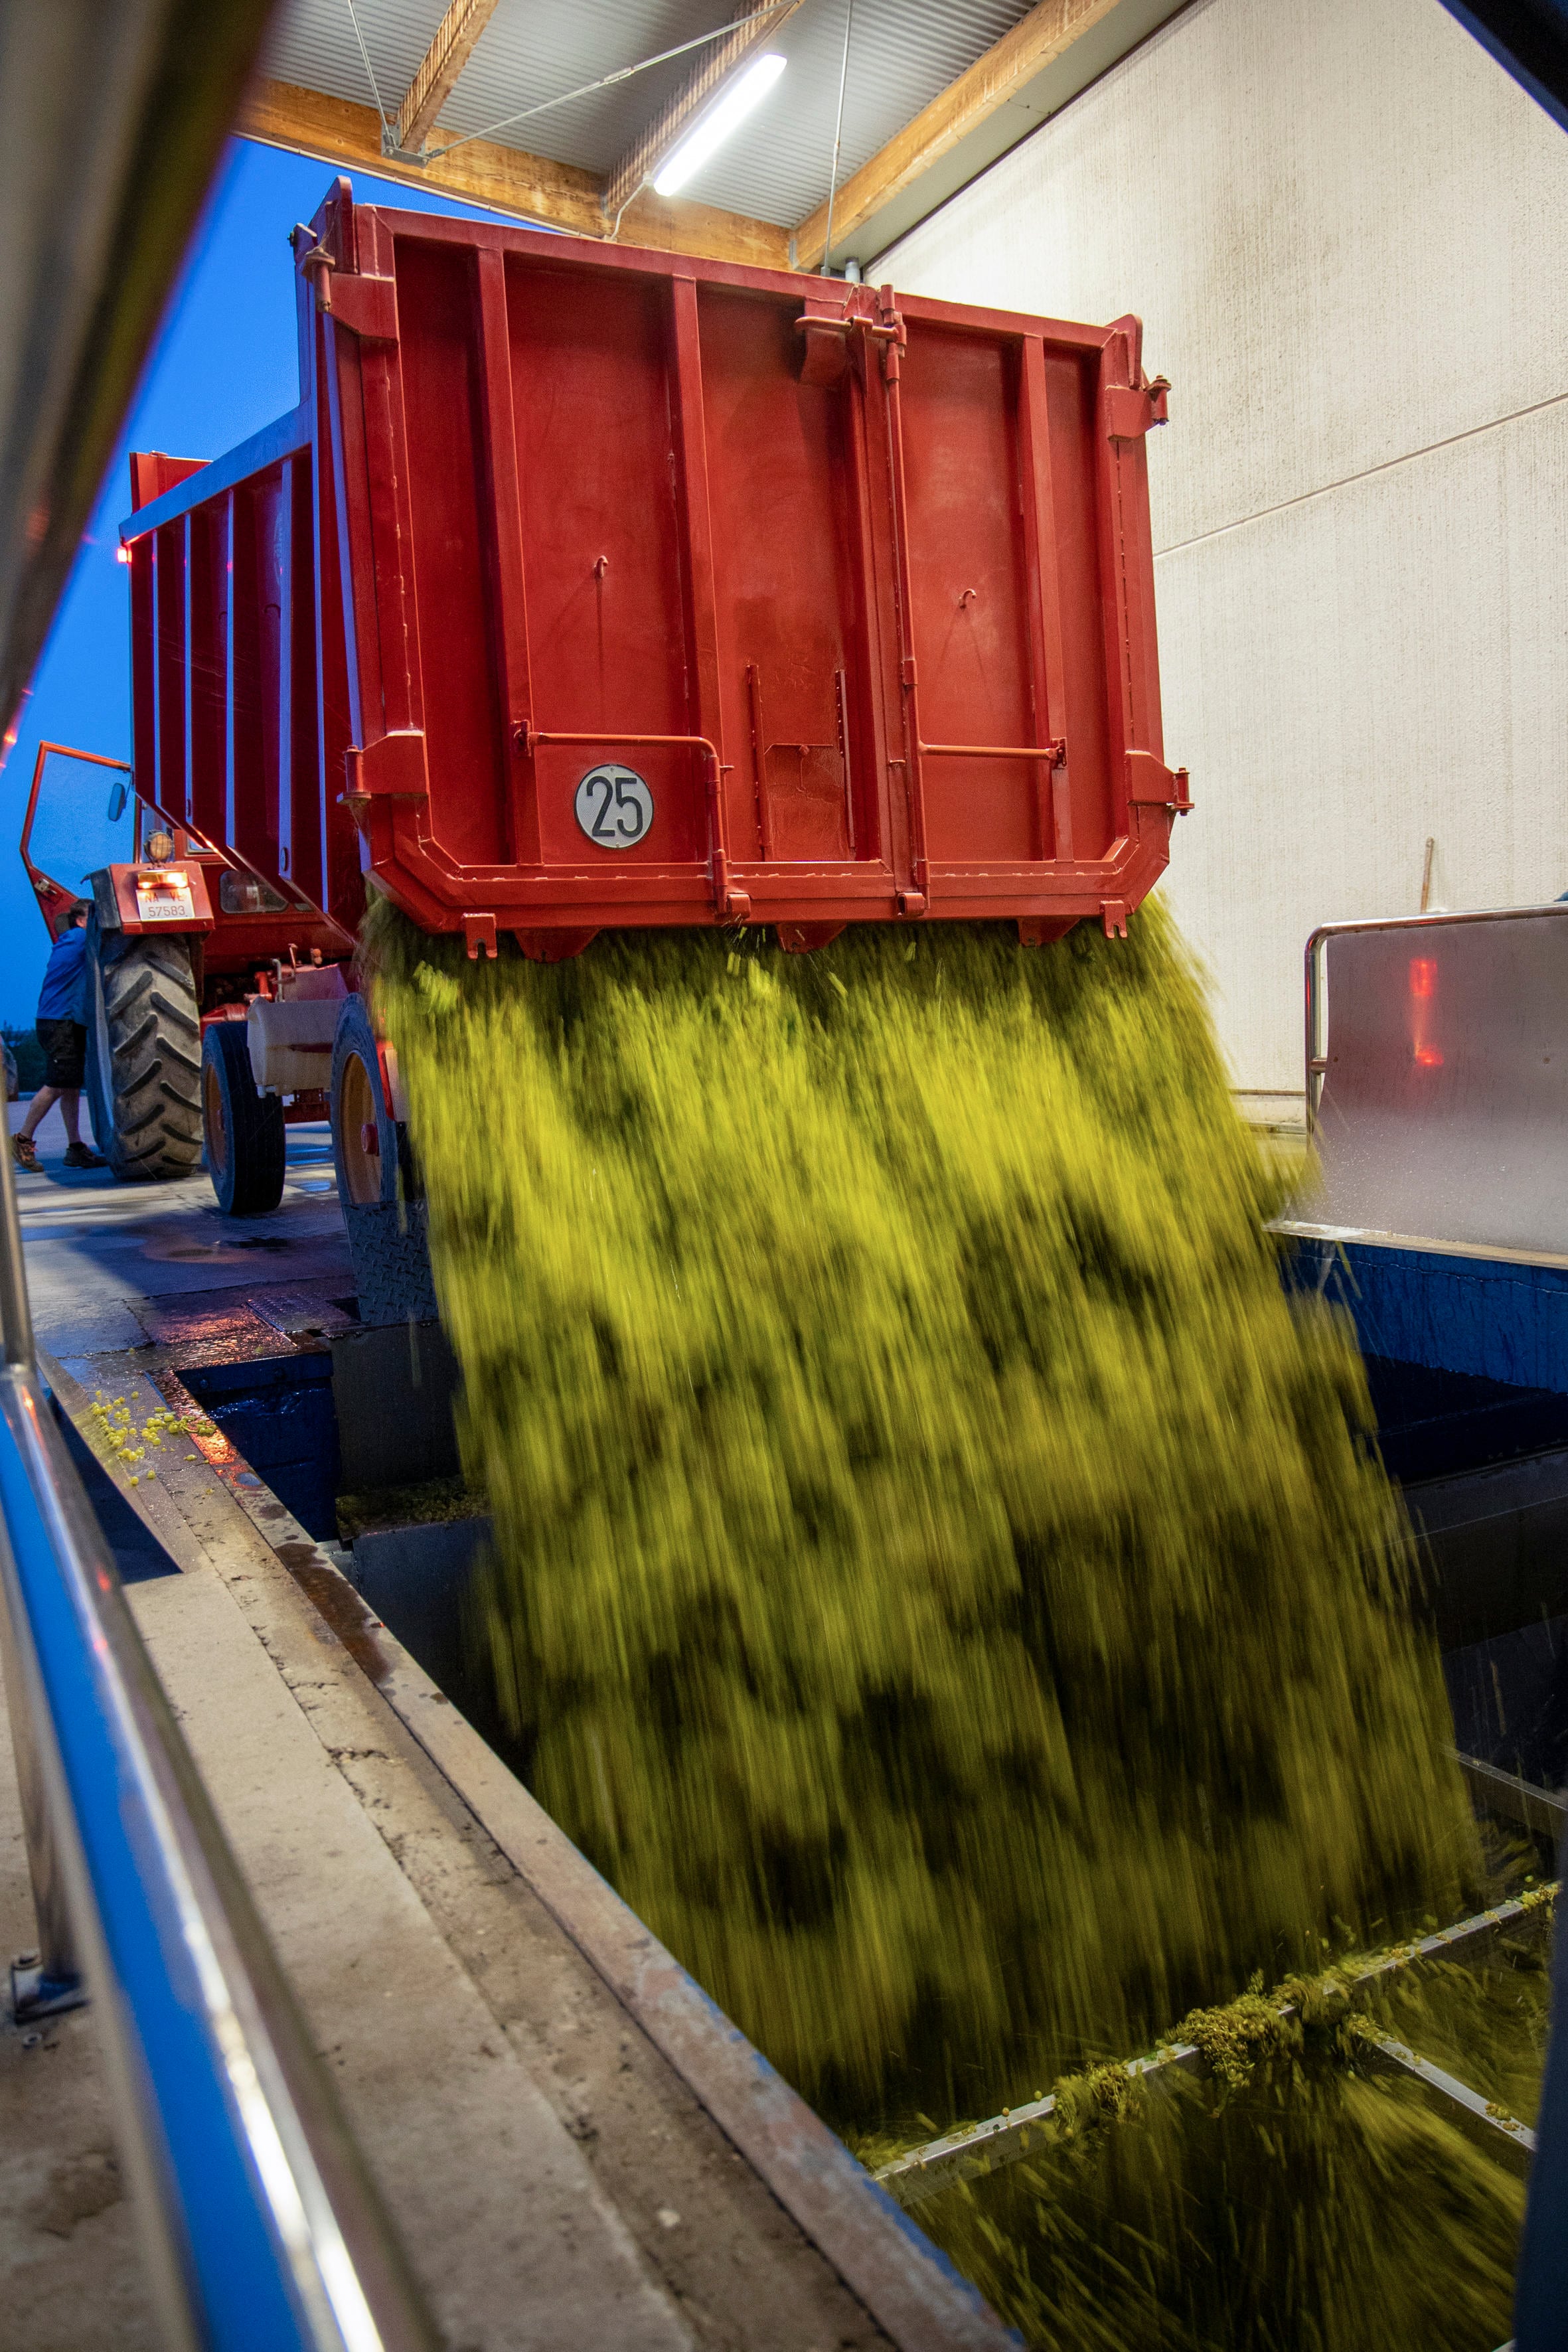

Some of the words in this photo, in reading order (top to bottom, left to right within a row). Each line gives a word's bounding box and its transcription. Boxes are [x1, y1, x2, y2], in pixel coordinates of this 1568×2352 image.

[586, 775, 643, 838] 25
[144, 892, 159, 903] NA
[169, 890, 185, 902] VE
[148, 905, 185, 917] 57583
